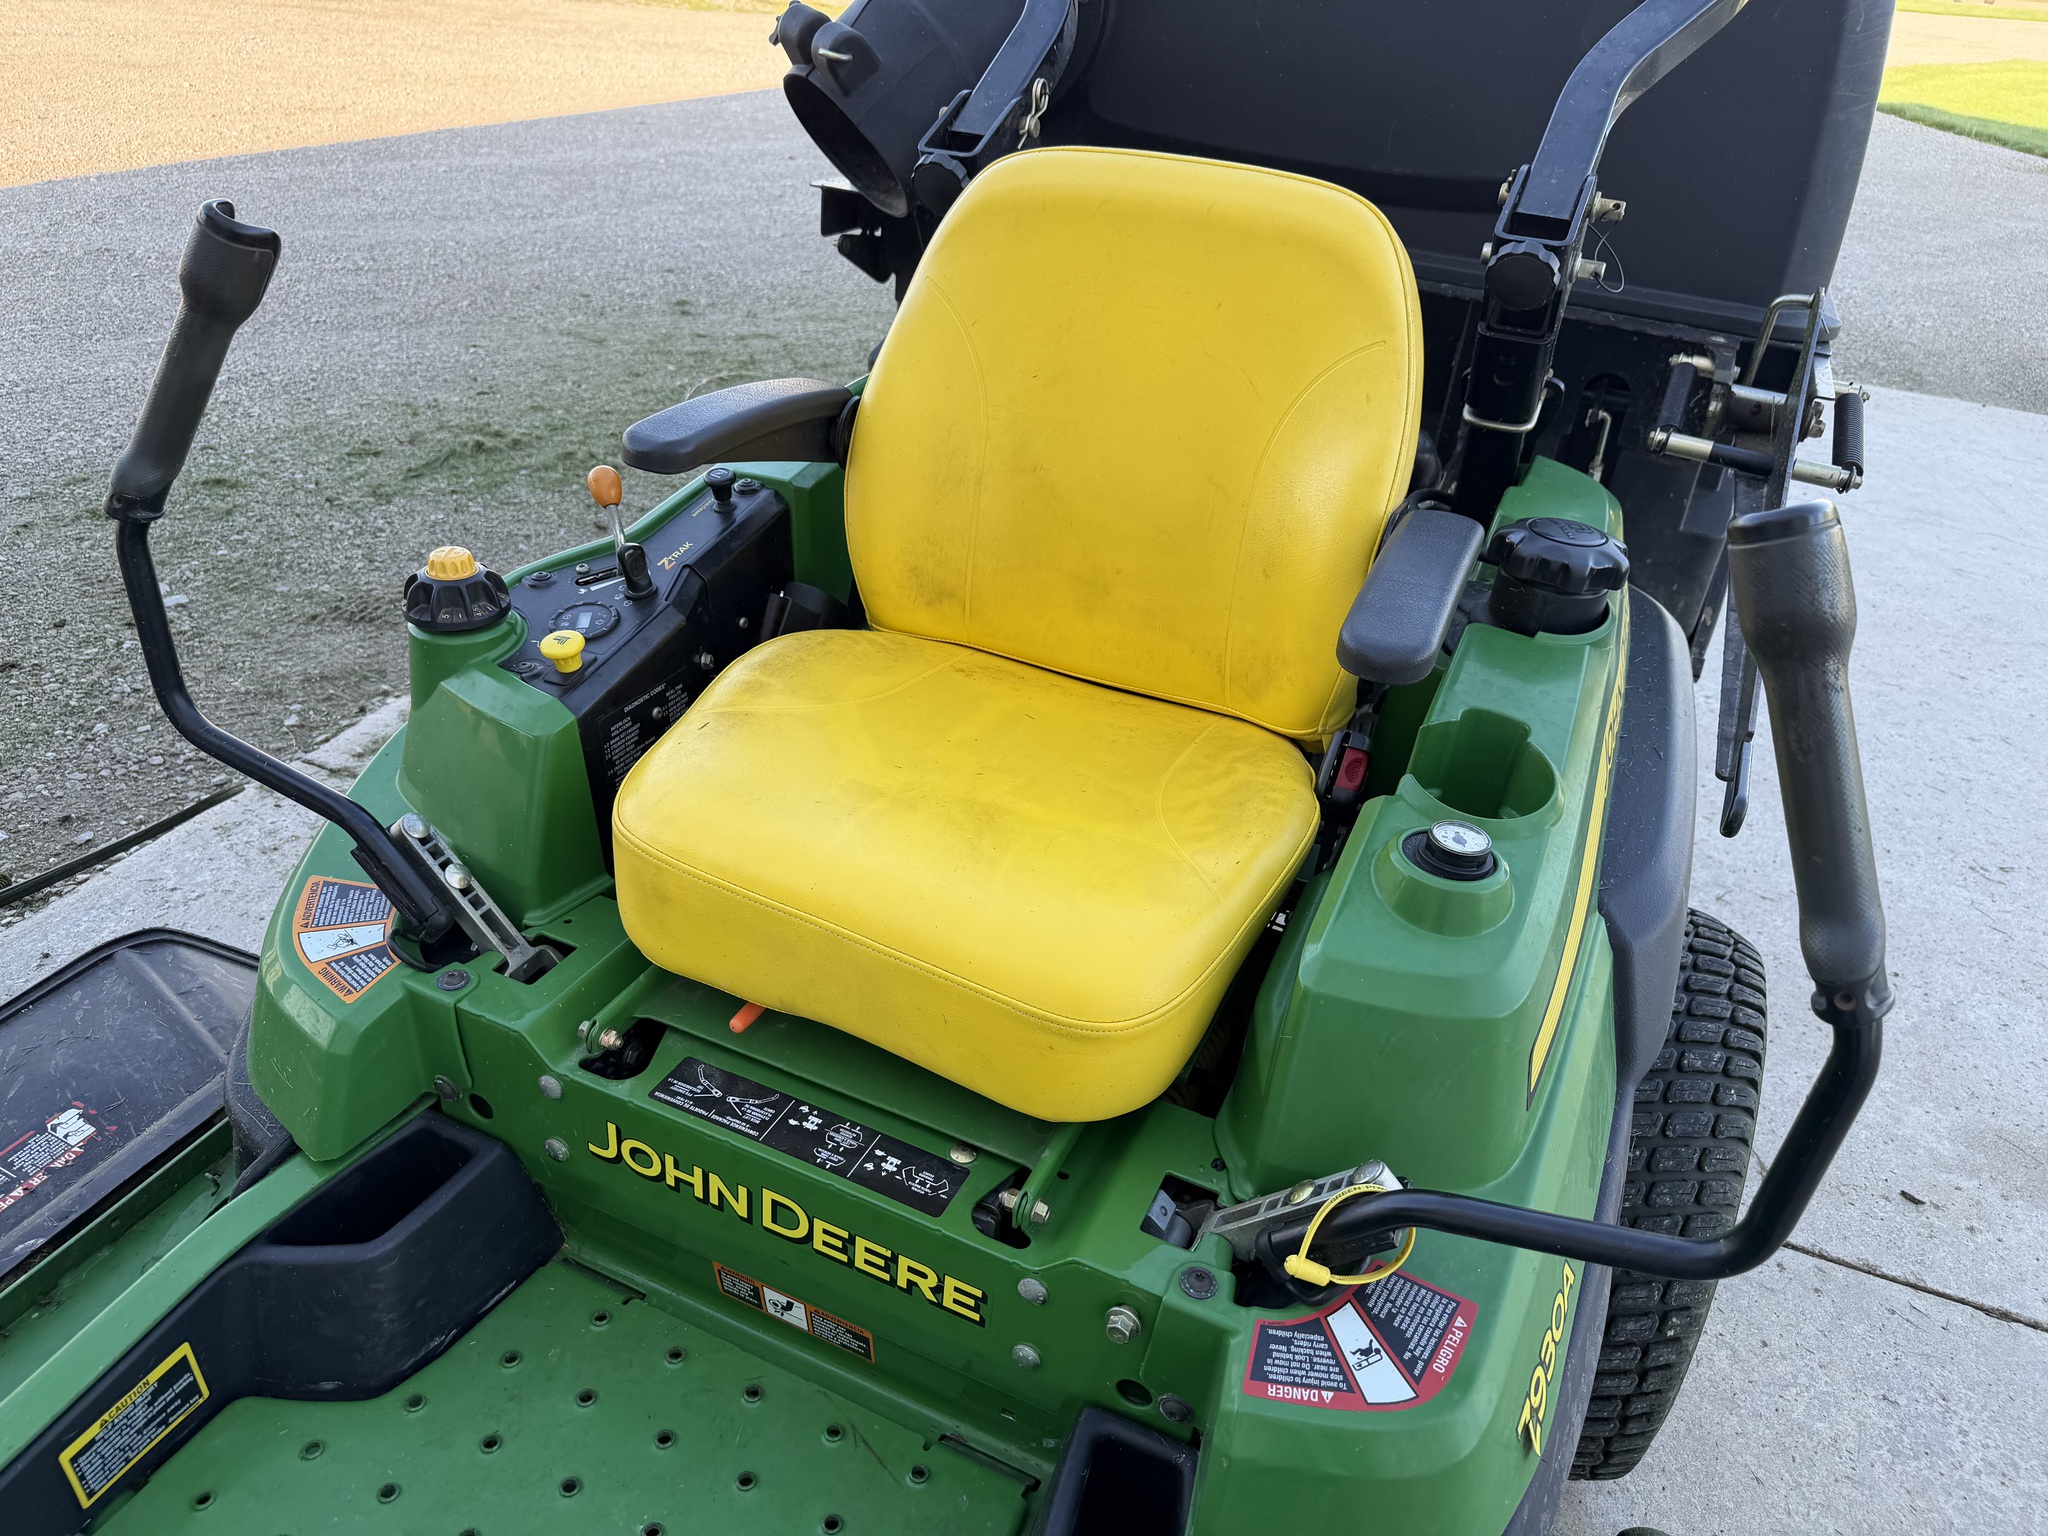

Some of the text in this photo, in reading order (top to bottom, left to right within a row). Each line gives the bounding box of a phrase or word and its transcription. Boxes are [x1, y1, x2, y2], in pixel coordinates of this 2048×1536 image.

[624, 693, 650, 713] DIAGNOSTIC
[302, 881, 320, 920] ADVERTENCIA
[318, 967, 347, 993] WARNING
[654, 1092, 683, 1105] CONVENIENCIA
[711, 1114, 730, 1124] PACKAGE
[730, 1122, 759, 1136] CONVENIENCE
[28, 1149, 76, 1186] DANER
[1330, 1185, 1361, 1204] GREEN
[588, 1121, 986, 1327] JOHN DEERE
[727, 1269, 755, 1284] WARNING
[1395, 1281, 1411, 1307] retroceder
[1404, 1285, 1419, 1307] mientras
[1415, 1288, 1426, 1303] Mirar
[1379, 1302, 1392, 1318] Nunca
[1405, 1291, 1433, 1338] cortar en retroceso.
[1408, 1302, 1419, 1317] hacia
[1445, 1301, 1456, 1313] Para
[1393, 1314, 1404, 1327] hace
[1421, 1316, 1430, 1325] las
[1429, 1303, 1445, 1327] segadora
[1438, 1313, 1449, 1329] evitar
[821, 1312, 864, 1334] ADVERTENCIA
[1267, 1328, 1324, 1341] especially children.
[1419, 1327, 1432, 1346] cuando
[1433, 1328, 1442, 1337] las
[1269, 1344, 1287, 1352] Never
[1291, 1345, 1314, 1355] backing.
[1292, 1339, 1328, 1349] carry riders,
[1413, 1346, 1423, 1356] hay
[1433, 1328, 1463, 1373] PELIGRO
[1273, 1351, 1293, 1360] behind
[1294, 1354, 1309, 1362] Look
[1403, 1351, 1412, 1360] No
[1516, 1258, 1575, 1462] Z930A
[1264, 1365, 1288, 1374] children
[1414, 1360, 1424, 1376] parar
[1267, 1372, 1293, 1382] children,
[1302, 1376, 1319, 1386] injury
[135, 1382, 157, 1405] INJURY
[1268, 1384, 1318, 1402] DANGER
[1339, 1382, 1347, 1390] To
[108, 1379, 150, 1419] CAUTION
